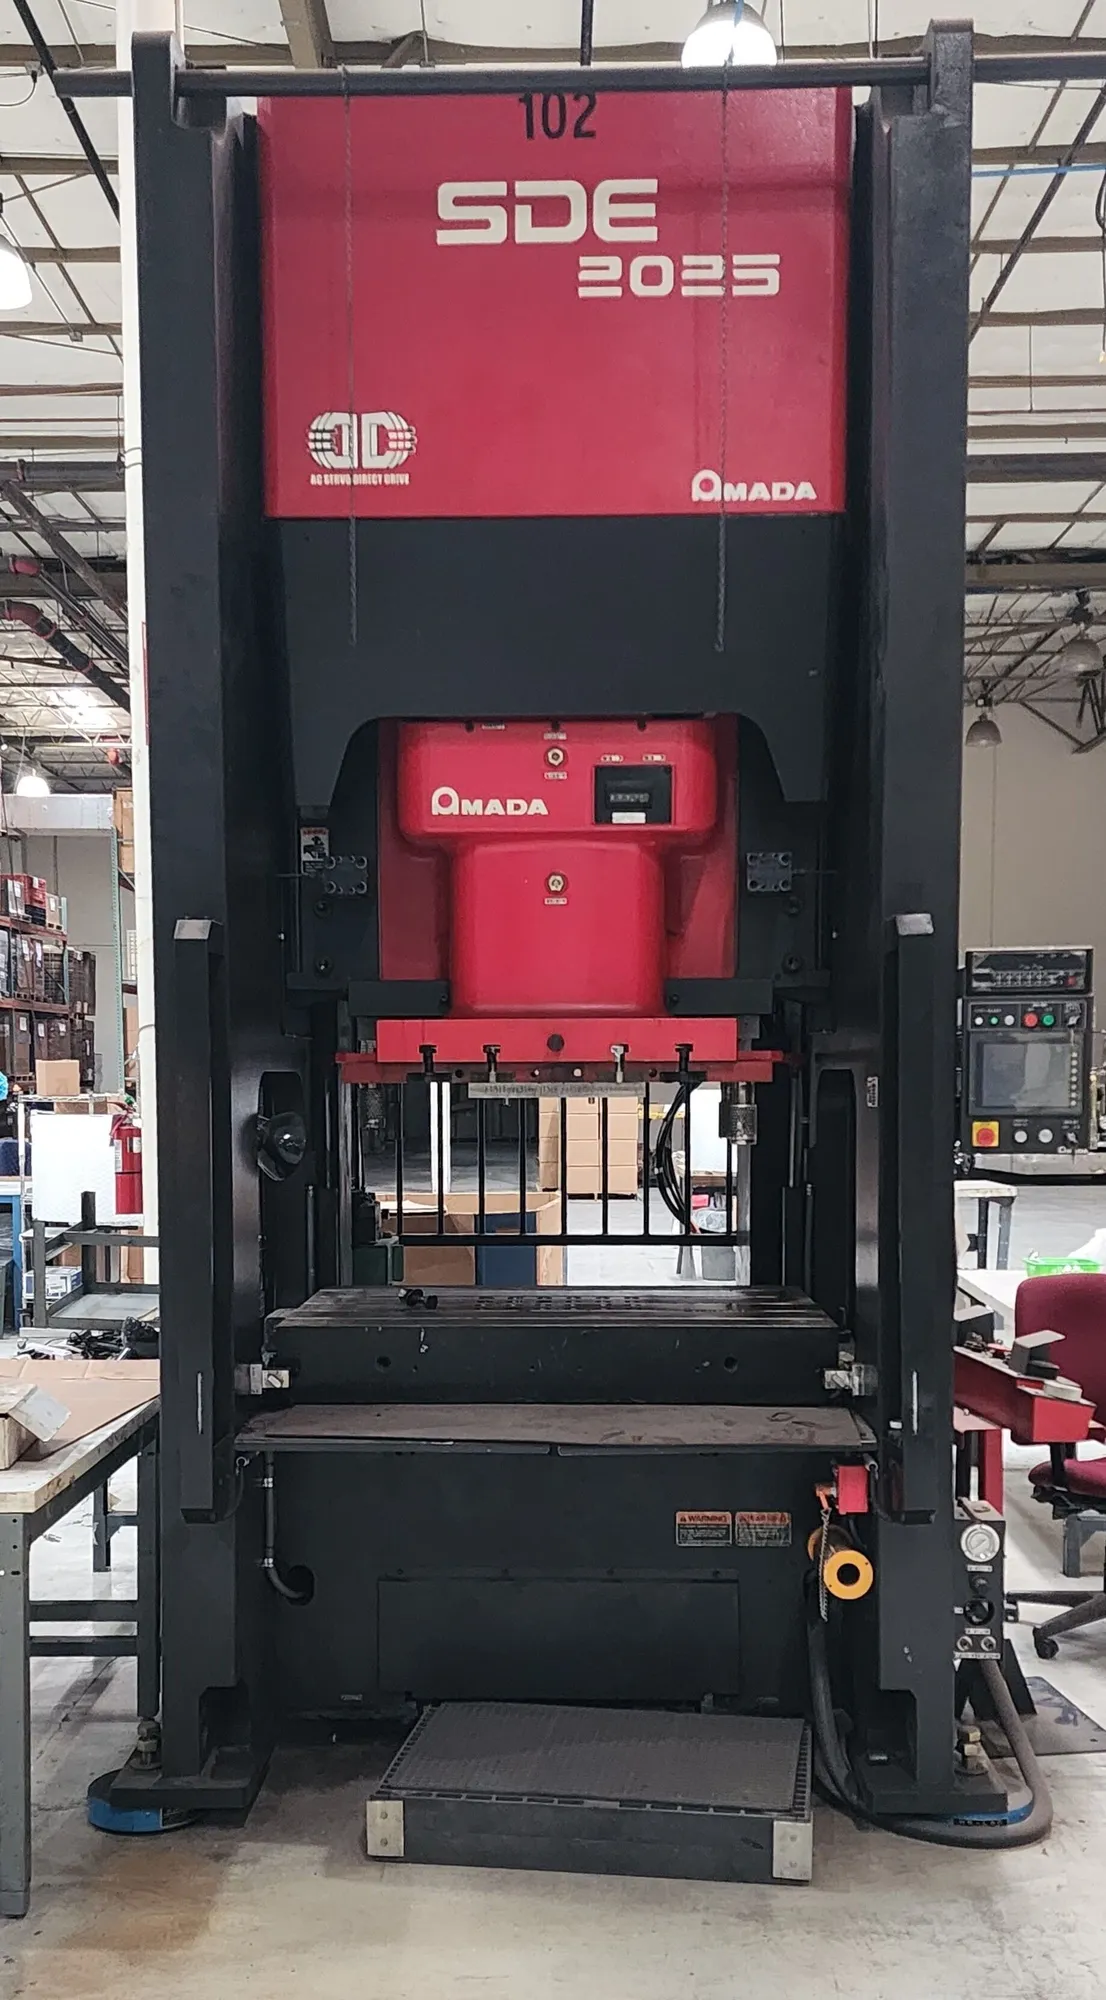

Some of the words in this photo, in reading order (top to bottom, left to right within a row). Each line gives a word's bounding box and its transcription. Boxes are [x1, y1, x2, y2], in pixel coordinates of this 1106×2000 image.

[519, 92, 597, 139] 102
[436, 179, 658, 245] SDE
[577, 254, 780, 298] 2025
[692, 469, 818, 502] AMADA
[431, 786, 549, 816] AMADA
